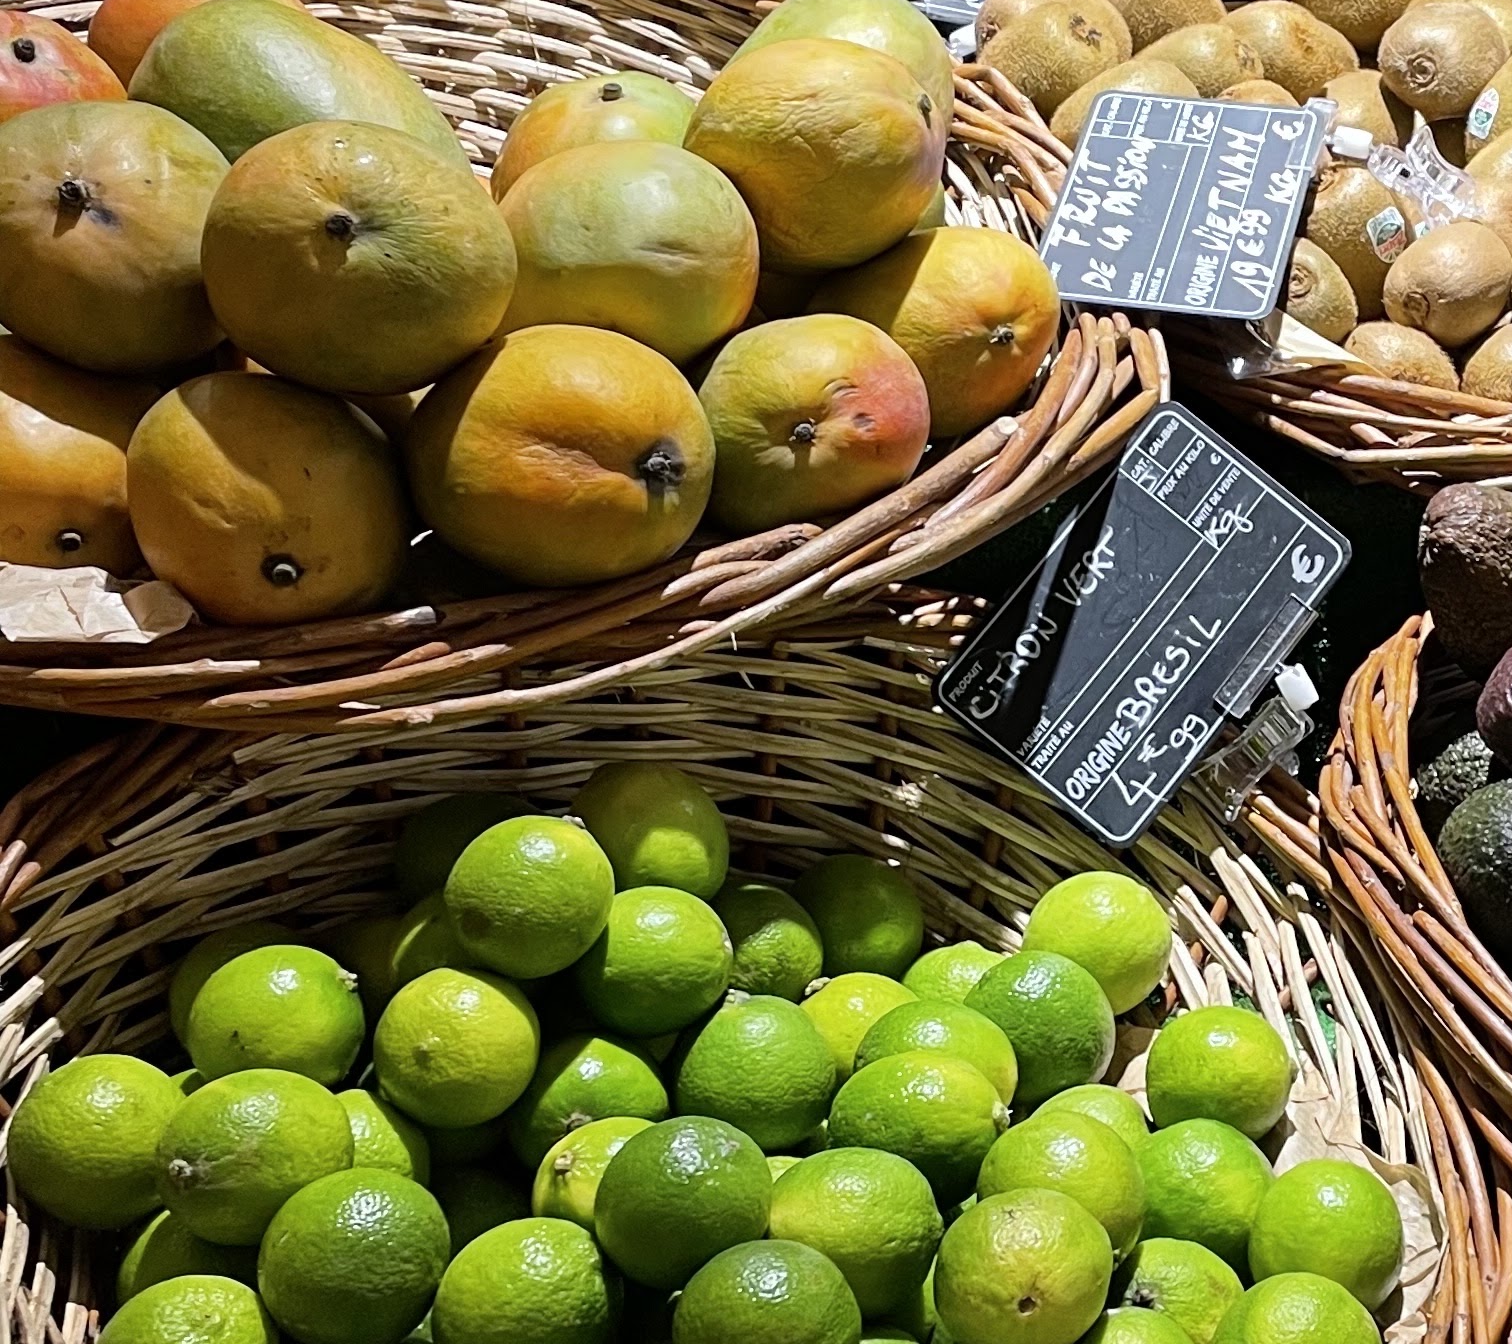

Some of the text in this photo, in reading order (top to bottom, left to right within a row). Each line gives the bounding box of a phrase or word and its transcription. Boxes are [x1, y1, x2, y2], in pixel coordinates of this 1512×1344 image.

[1080, 257, 1118, 293] DE
[1184, 254, 1219, 306] ORIGINE
[1148, 418, 1180, 457] CALIBRE
[1157, 439, 1206, 501] PRIX AU KILO
[1209, 489, 1223, 506] DE
[1218, 466, 1242, 495] VENTE
[1055, 525, 1116, 607] VERT
[948, 660, 984, 703] PRODUIT
[1058, 722, 1076, 741] AU
[1065, 719, 1132, 800] ORIGINE
